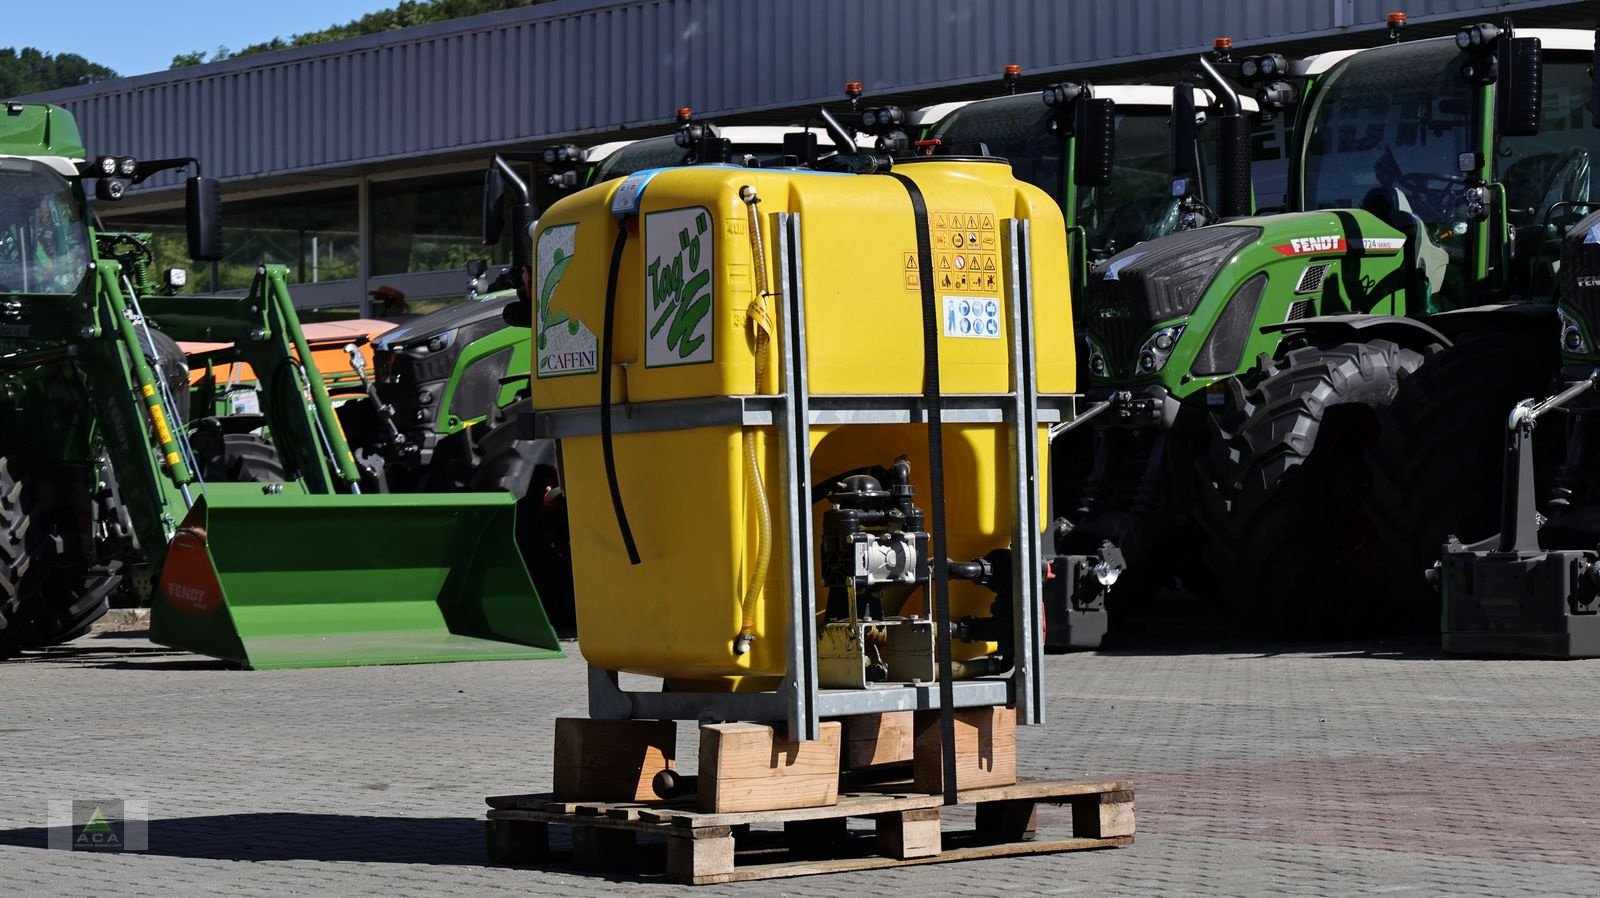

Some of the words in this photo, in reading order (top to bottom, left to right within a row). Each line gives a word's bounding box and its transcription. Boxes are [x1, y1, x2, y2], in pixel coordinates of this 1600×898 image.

[1290, 235, 1340, 253] FENDT
[1363, 239, 1377, 248] 724
[547, 351, 595, 370] CAFFINI
[167, 582, 206, 603] FENDT
